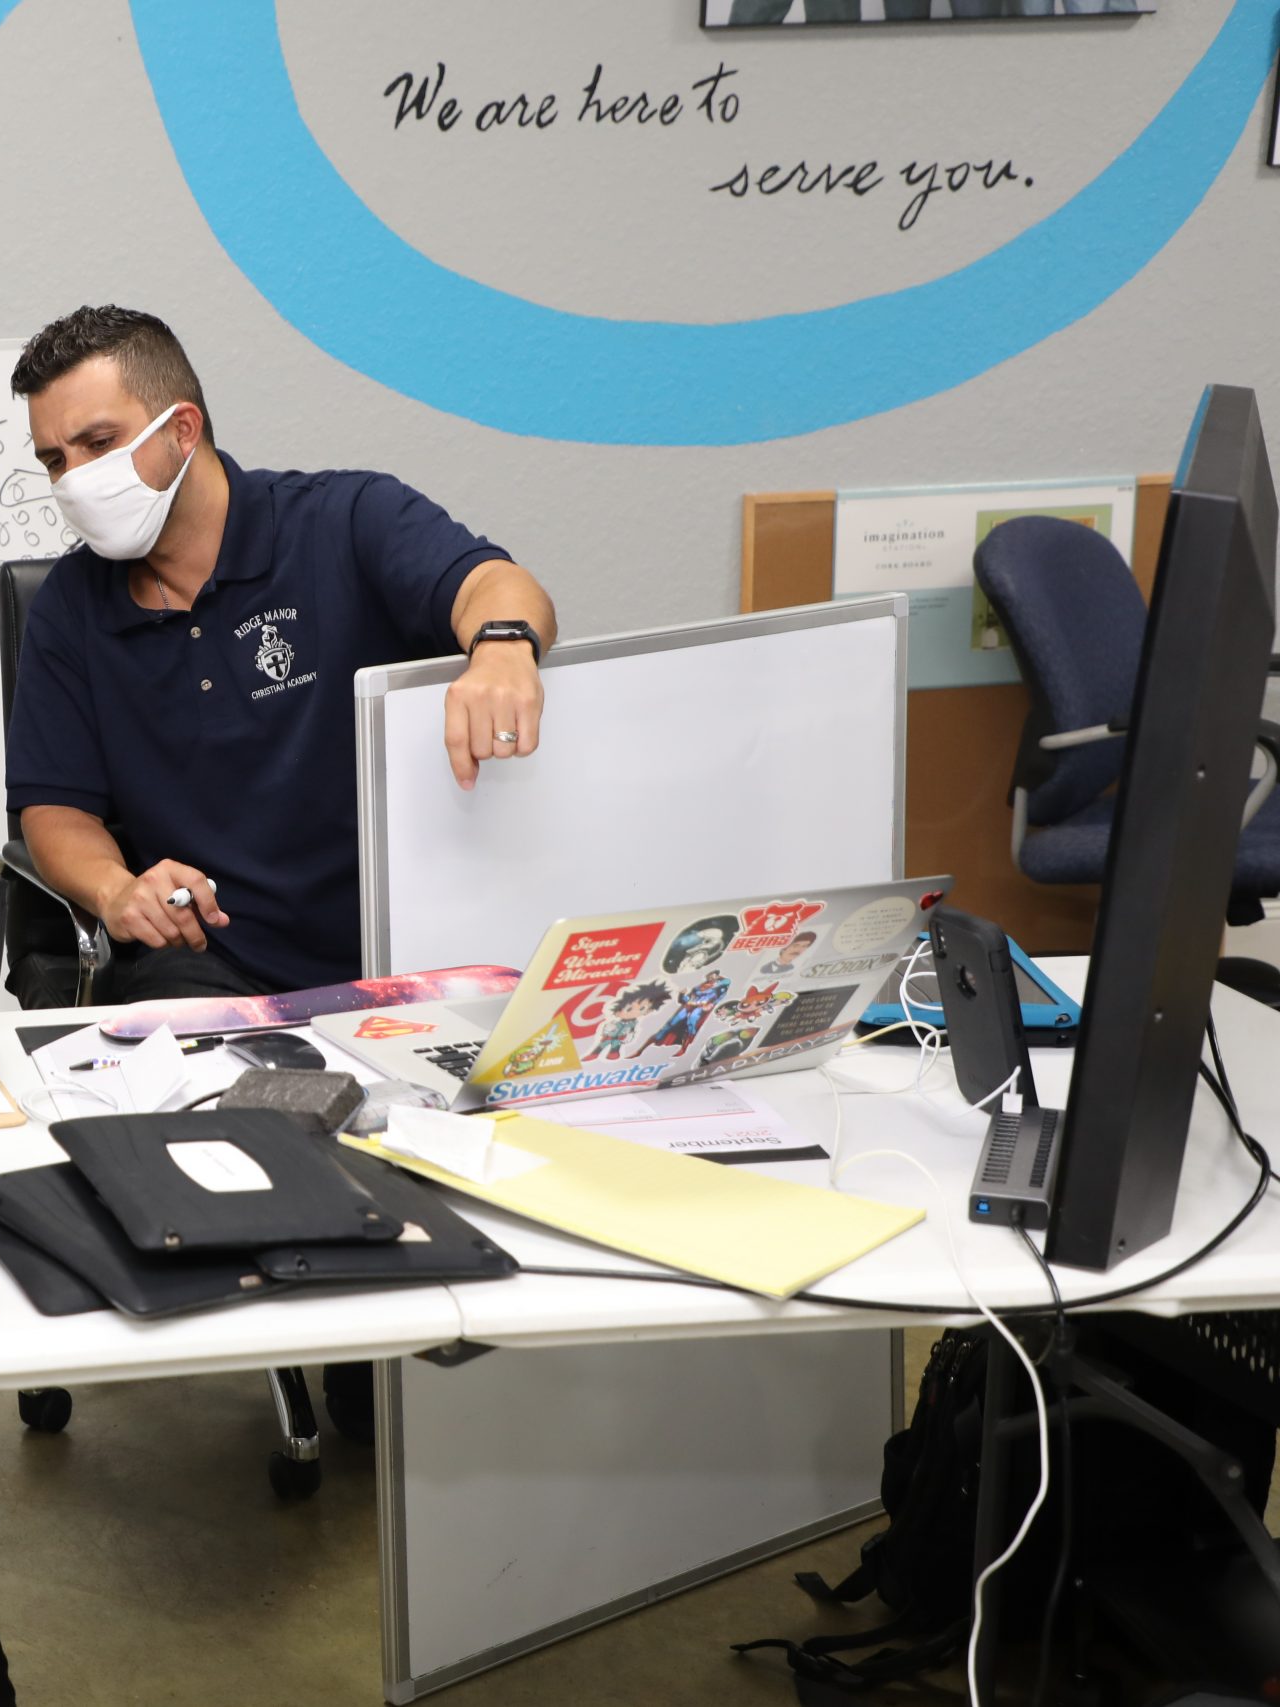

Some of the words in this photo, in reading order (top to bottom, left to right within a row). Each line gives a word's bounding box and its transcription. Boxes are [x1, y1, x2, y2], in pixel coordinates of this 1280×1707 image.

[383, 61, 462, 130] We
[475, 91, 559, 130] are
[577, 63, 683, 125] here
[692, 61, 739, 124] to
[709, 161, 883, 197] serve
[900, 159, 1034, 230] you.
[863, 528, 945, 543] imagination
[233, 614, 263, 640] RIDGE
[263, 607, 298, 622] MANOR
[251, 682, 286, 700] CHRISTIAN
[286, 671, 318, 689] ACADEMY
[571, 936, 619, 954] Signs
[732, 934, 792, 949] BEARS
[563, 952, 642, 969] Wonders
[553, 965, 632, 984] Miracles
[539, 1056, 564, 1068] LINK
[486, 1061, 668, 1103] Sweetwater
[668, 1135, 783, 1149] September
